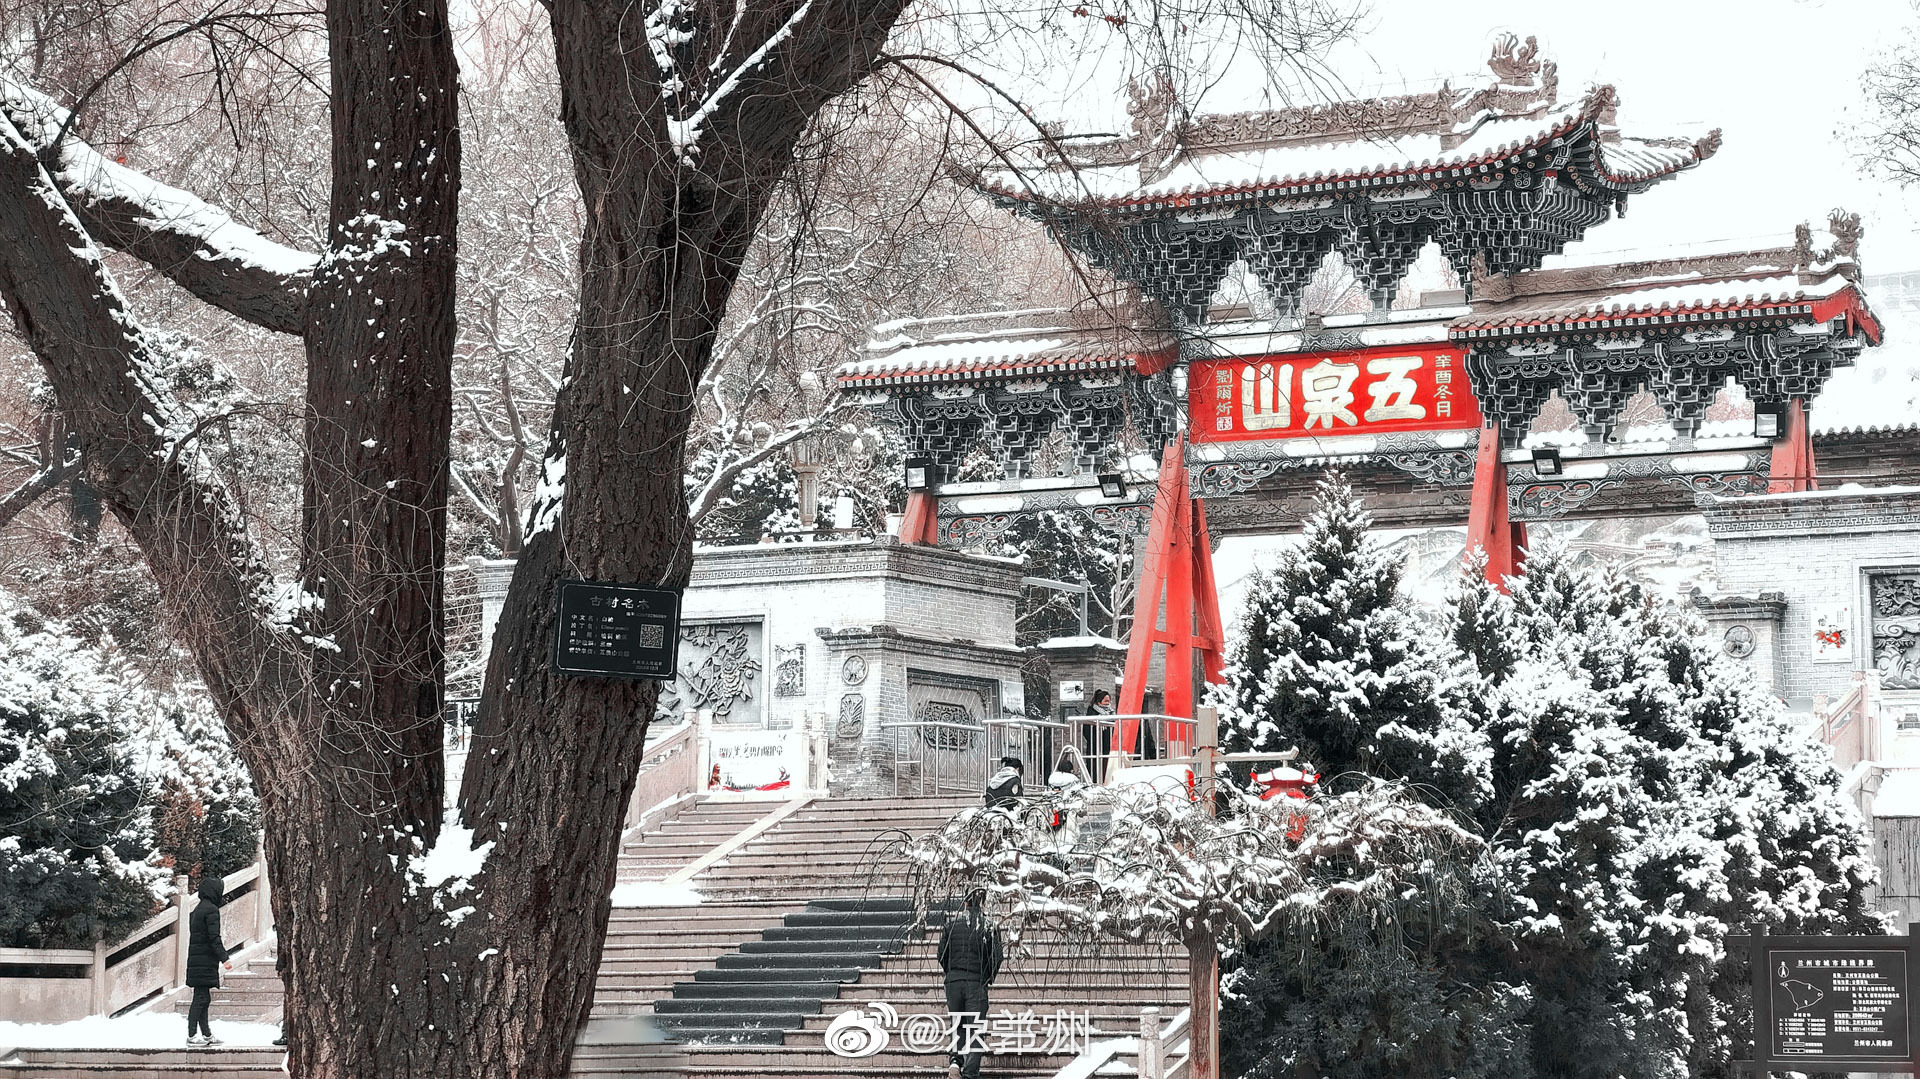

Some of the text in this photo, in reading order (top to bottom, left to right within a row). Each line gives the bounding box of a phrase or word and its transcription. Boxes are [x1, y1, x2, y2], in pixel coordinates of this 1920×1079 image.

[1241, 355, 1428, 432] 五泉山
[1433, 354, 1454, 418] 辛酉冬月
[590, 595, 650, 610] 古树名木
